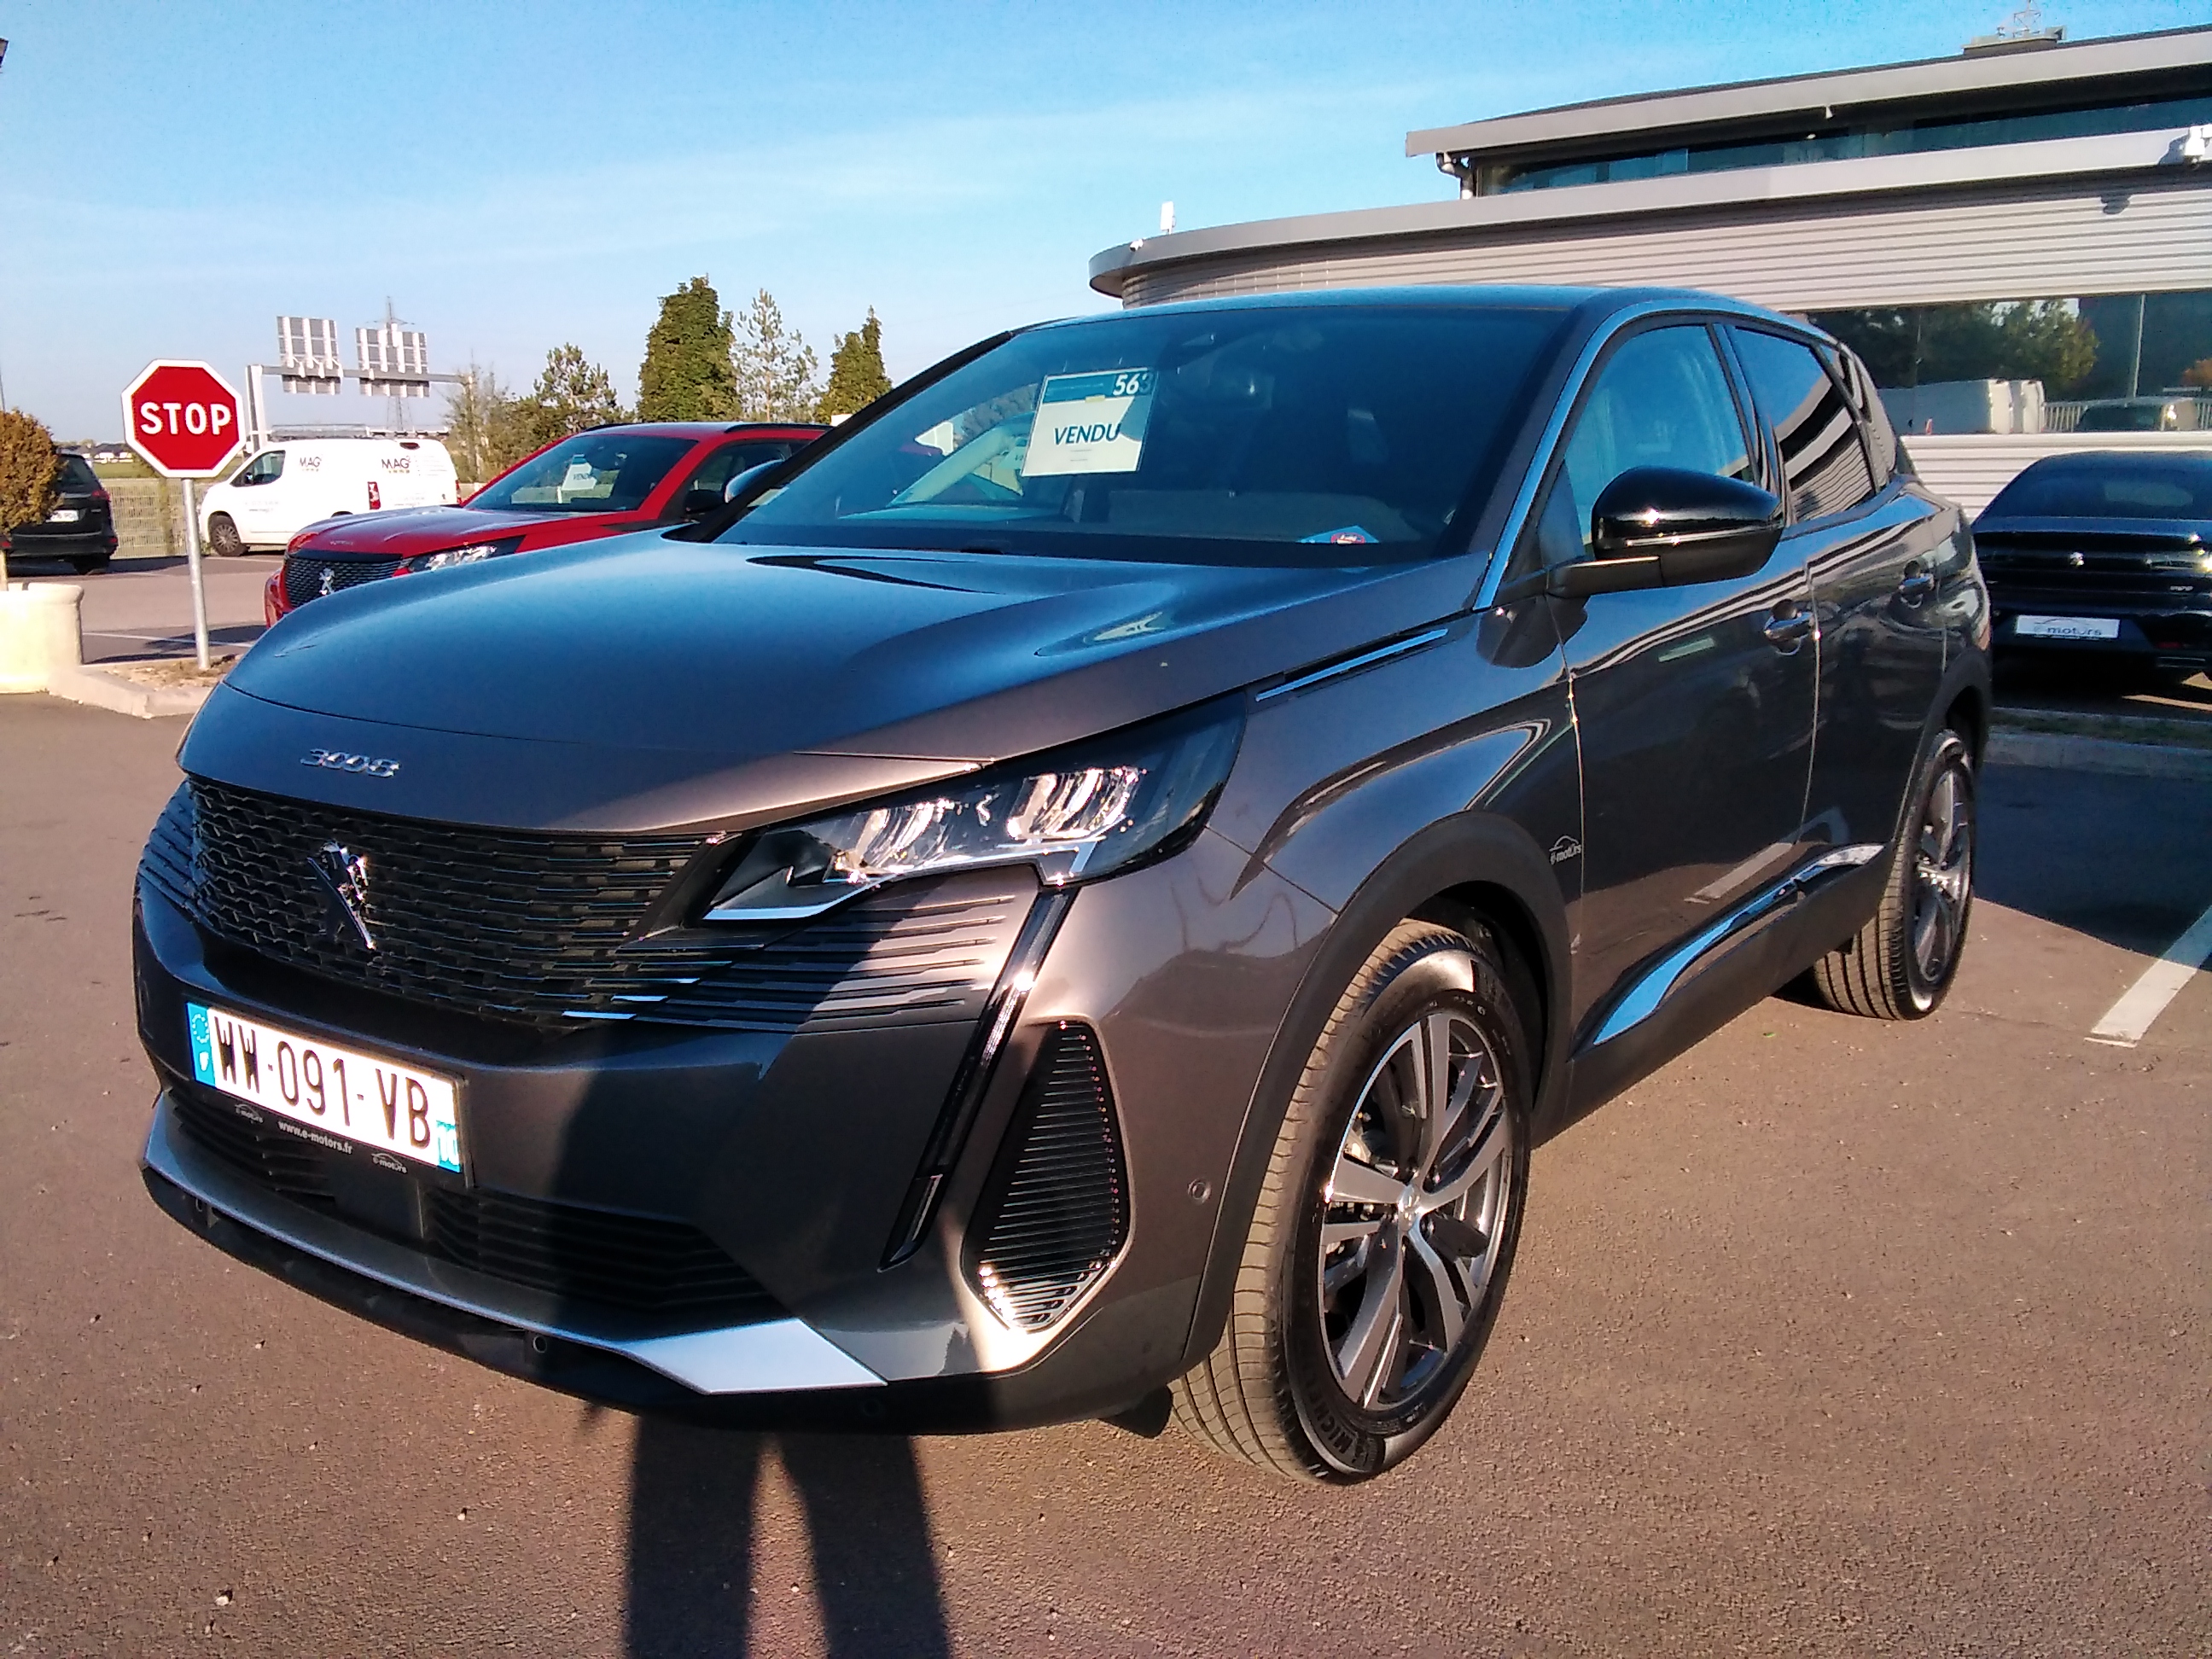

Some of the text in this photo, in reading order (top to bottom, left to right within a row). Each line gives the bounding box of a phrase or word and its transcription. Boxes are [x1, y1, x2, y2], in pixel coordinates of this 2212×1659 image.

[140, 401, 231, 435] STOP
[1054, 423, 1122, 445] VENDU
[300, 748, 400, 777] 3008
[214, 1016, 431, 1150] WW-091-VB
[277, 1121, 353, 1155] www.e-motors.fr
